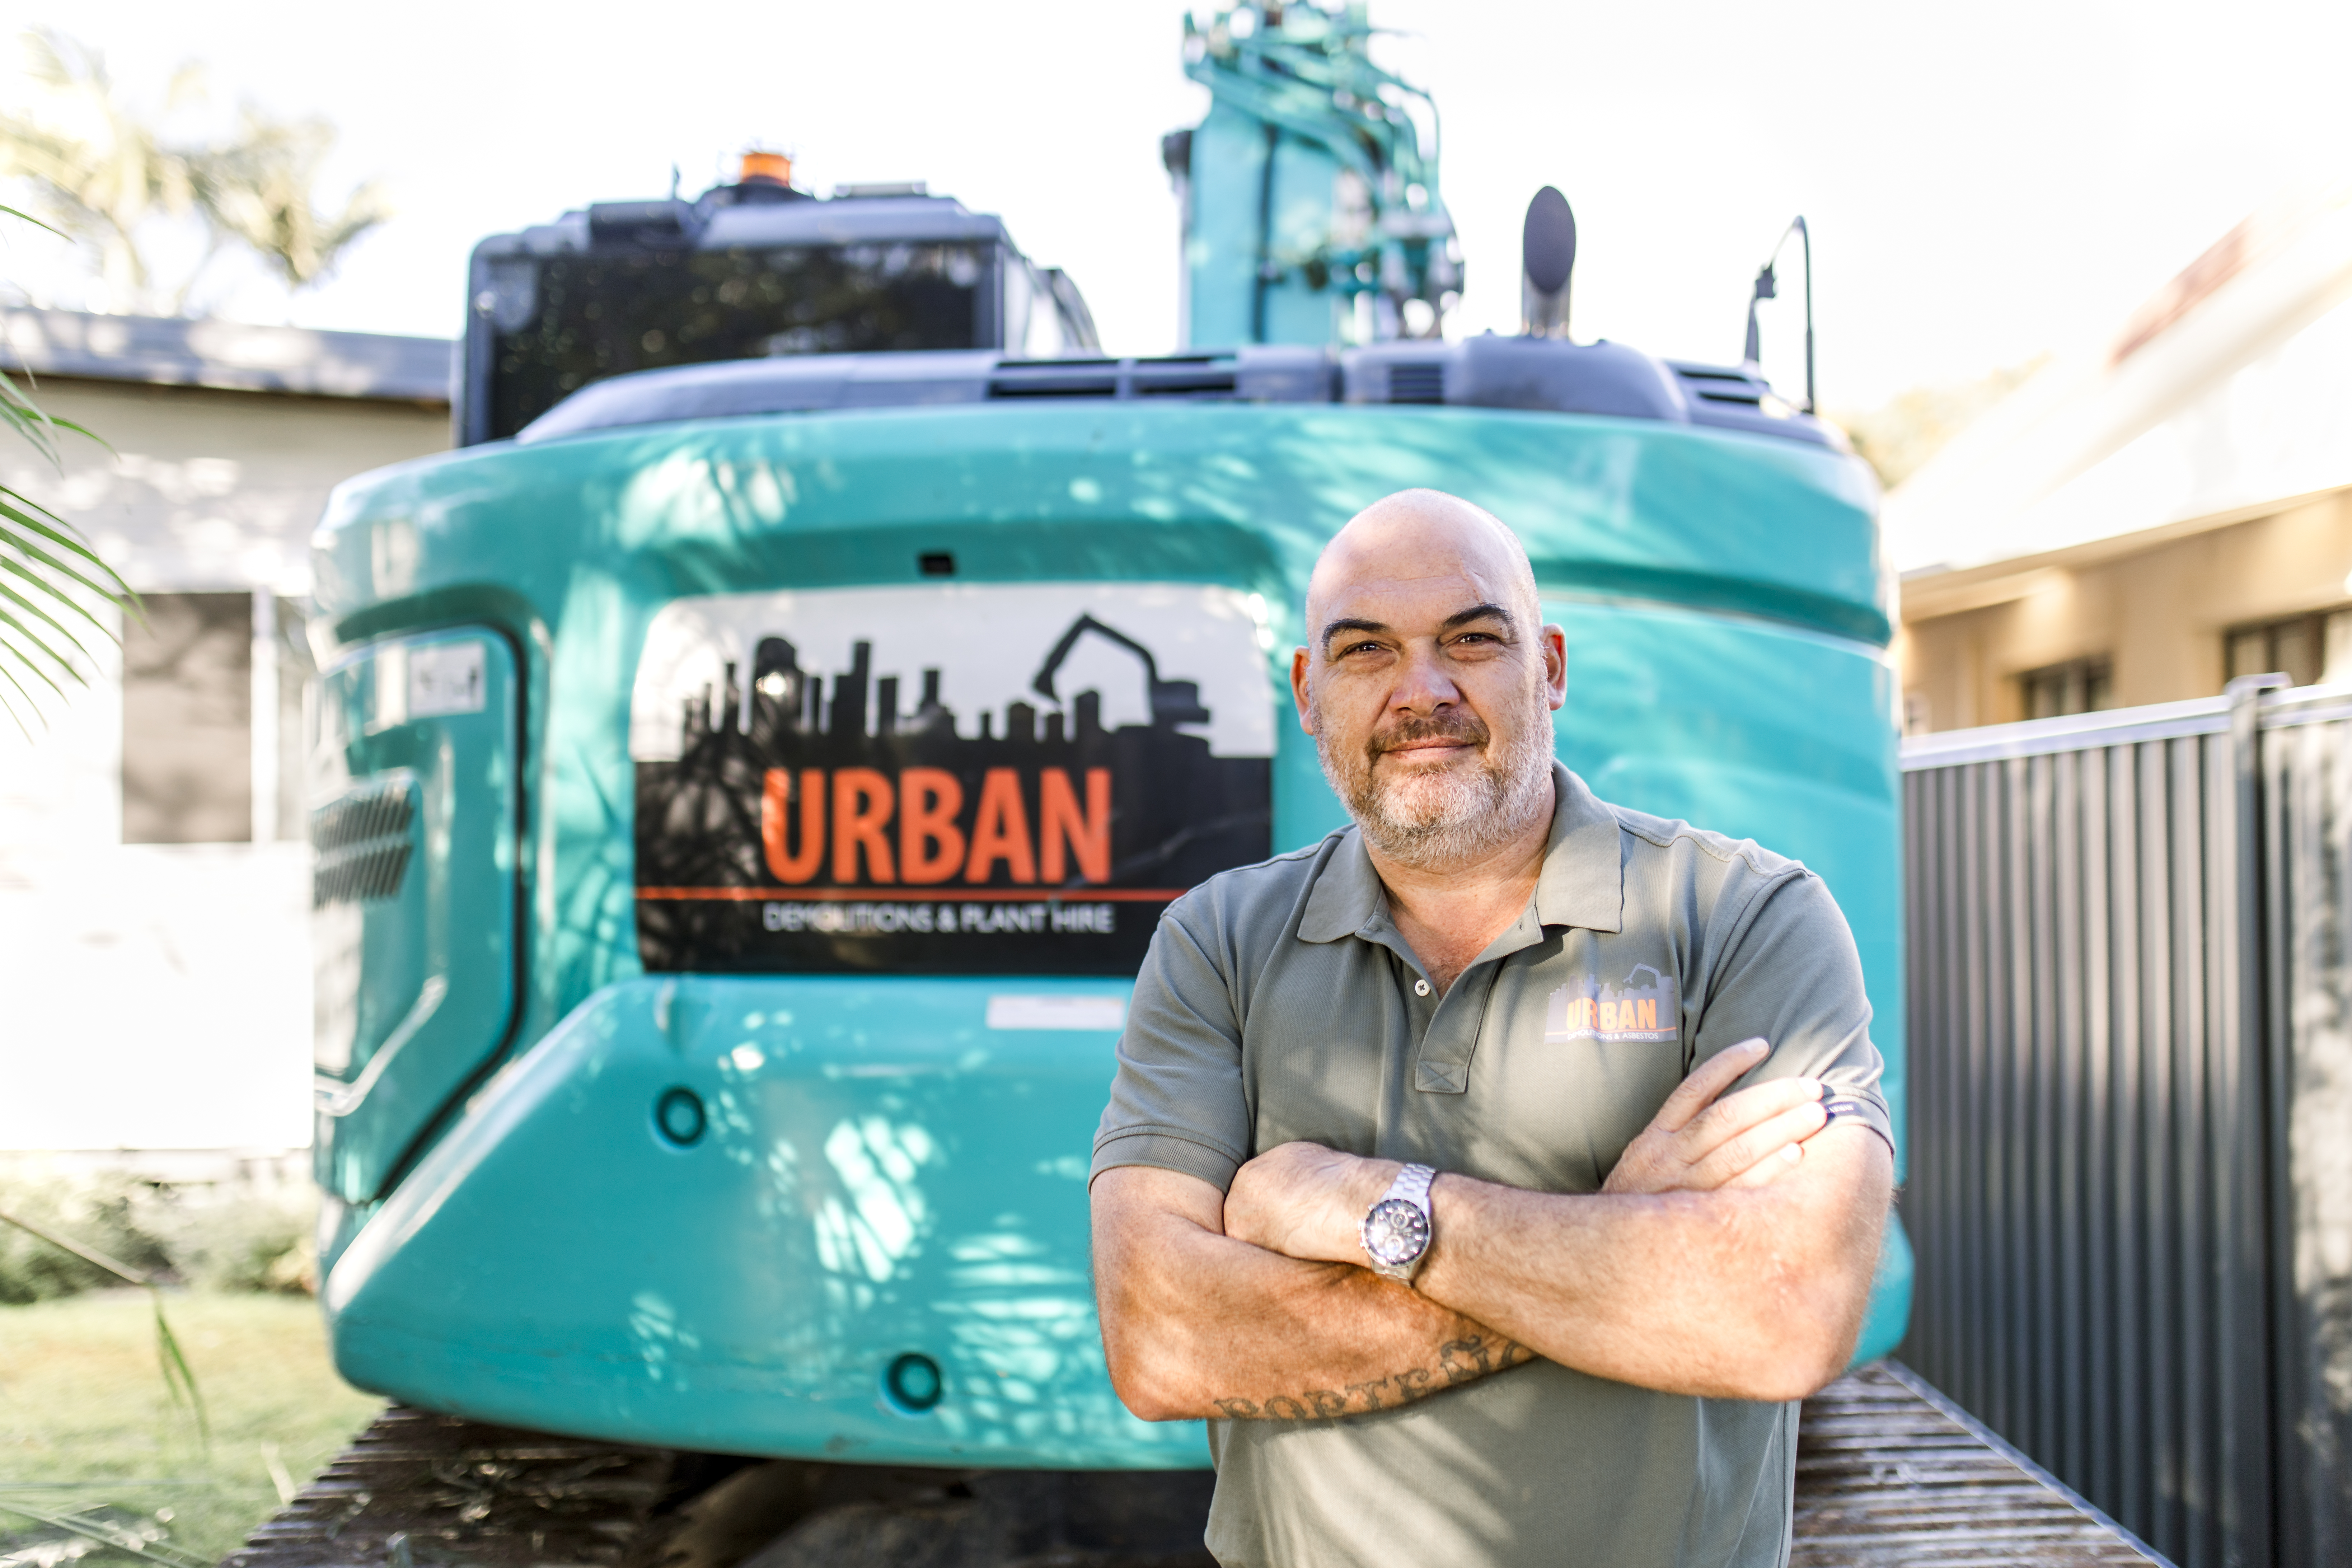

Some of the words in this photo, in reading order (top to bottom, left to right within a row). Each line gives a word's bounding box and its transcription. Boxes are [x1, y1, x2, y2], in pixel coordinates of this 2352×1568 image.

[762, 767, 1112, 884] URBAN
[762, 901, 934, 933] DEMOLITIONS
[935, 902, 958, 933] &
[960, 902, 1047, 933] PLANT
[1050, 902, 1115, 933] HIRE
[1566, 997, 1657, 1030] URBAN
[1568, 1029, 1613, 1040] DEMOLITIONS
